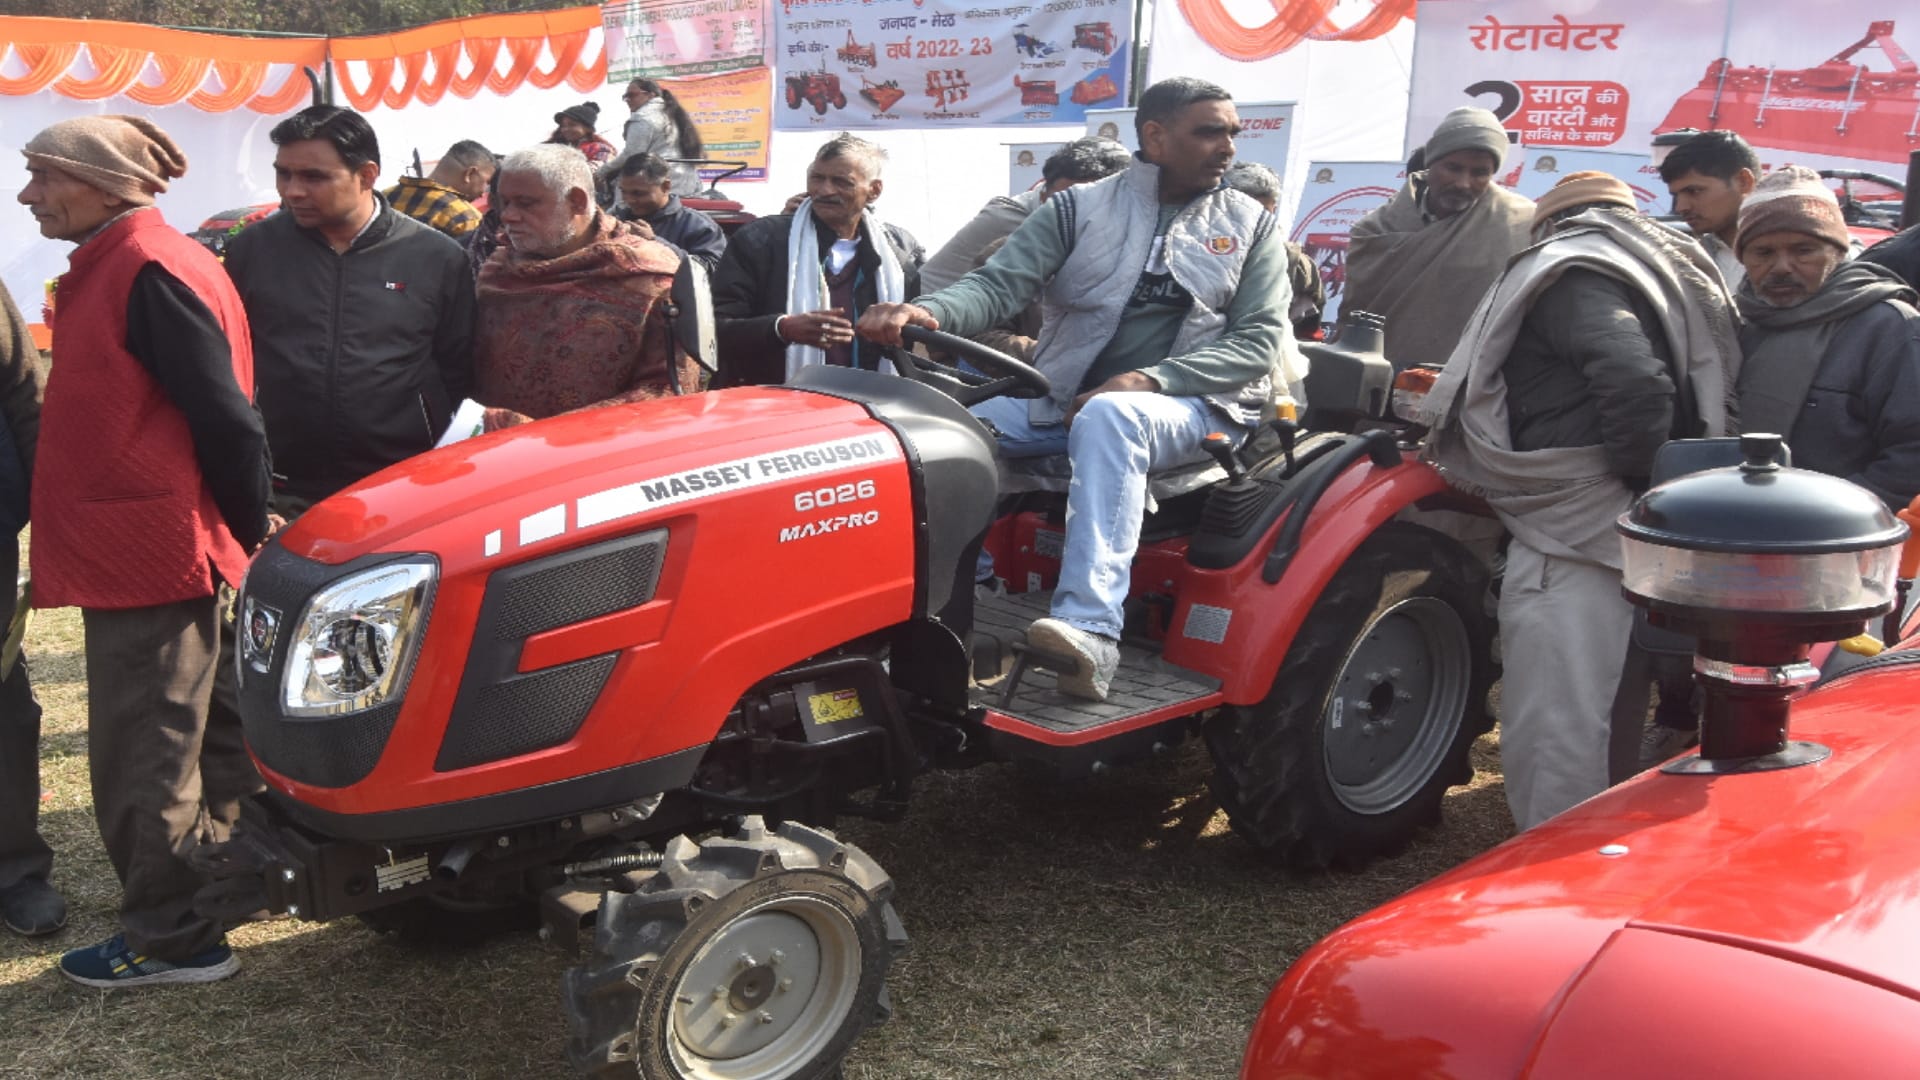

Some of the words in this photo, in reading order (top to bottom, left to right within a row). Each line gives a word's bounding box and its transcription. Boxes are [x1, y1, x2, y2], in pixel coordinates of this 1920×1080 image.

[879, 16, 918, 30] जनपद
[931, 10, 956, 28] मेरठ
[1468, 14, 1625, 51] रोटावेटर
[787, 40, 806, 56] कृषि
[885, 35, 912, 59] वर्ष
[970, 36, 992, 56] 23
[1464, 80, 1521, 144] 2
[1529, 86, 1592, 105] साल
[1595, 88, 1621, 105] की
[1526, 105, 1587, 126] वारंटी
[1590, 113, 1617, 127] और
[1525, 127, 1563, 142] सर्विस
[1566, 128, 1582, 142] के
[1584, 130, 1615, 142] साथ
[640, 462, 753, 503] MASSEY
[759, 438, 885, 477] FERGUSON
[794, 480, 876, 511] 6026
[778, 510, 880, 544] MAXPRO
